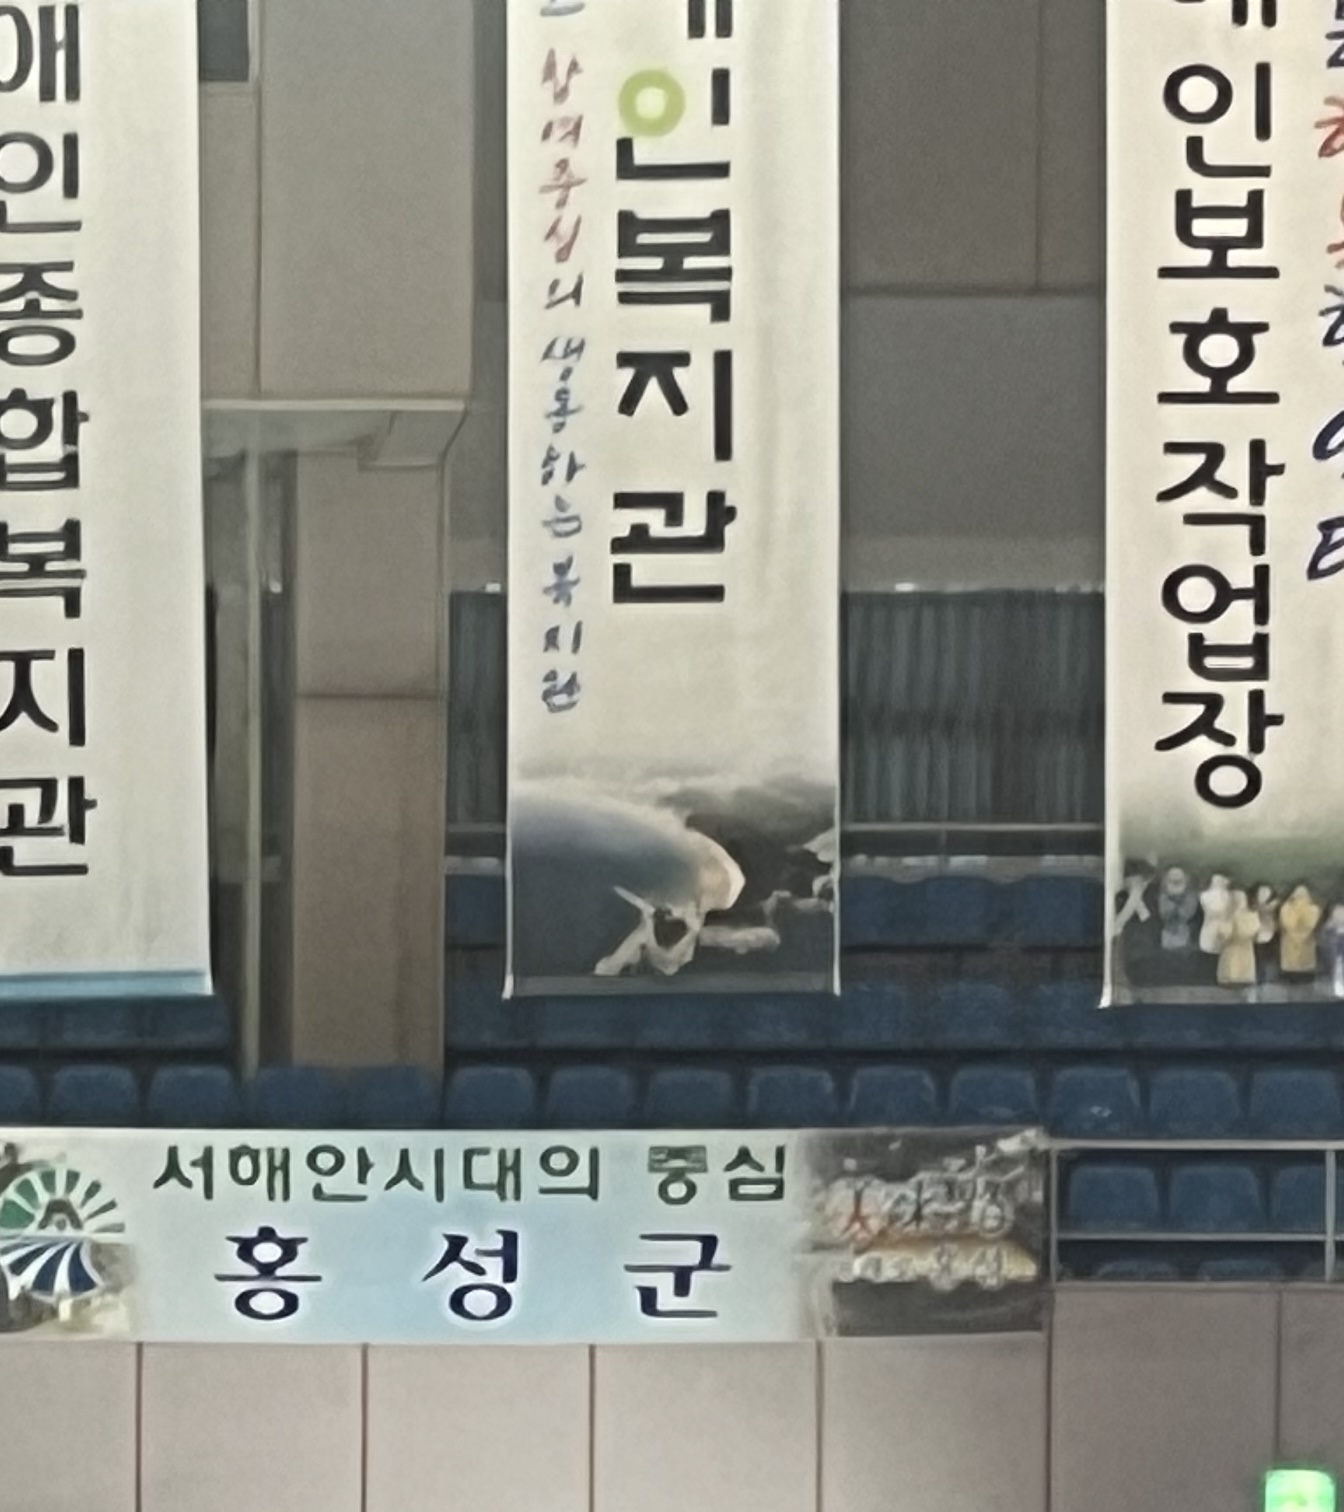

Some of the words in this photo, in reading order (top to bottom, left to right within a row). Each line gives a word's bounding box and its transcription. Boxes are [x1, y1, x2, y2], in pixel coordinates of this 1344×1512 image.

[1155, 0, 1286, 810] 인보호작업장
[153, 1143, 602, 1203] 서해안시대의
[646, 1143, 790, 1204] 중심
